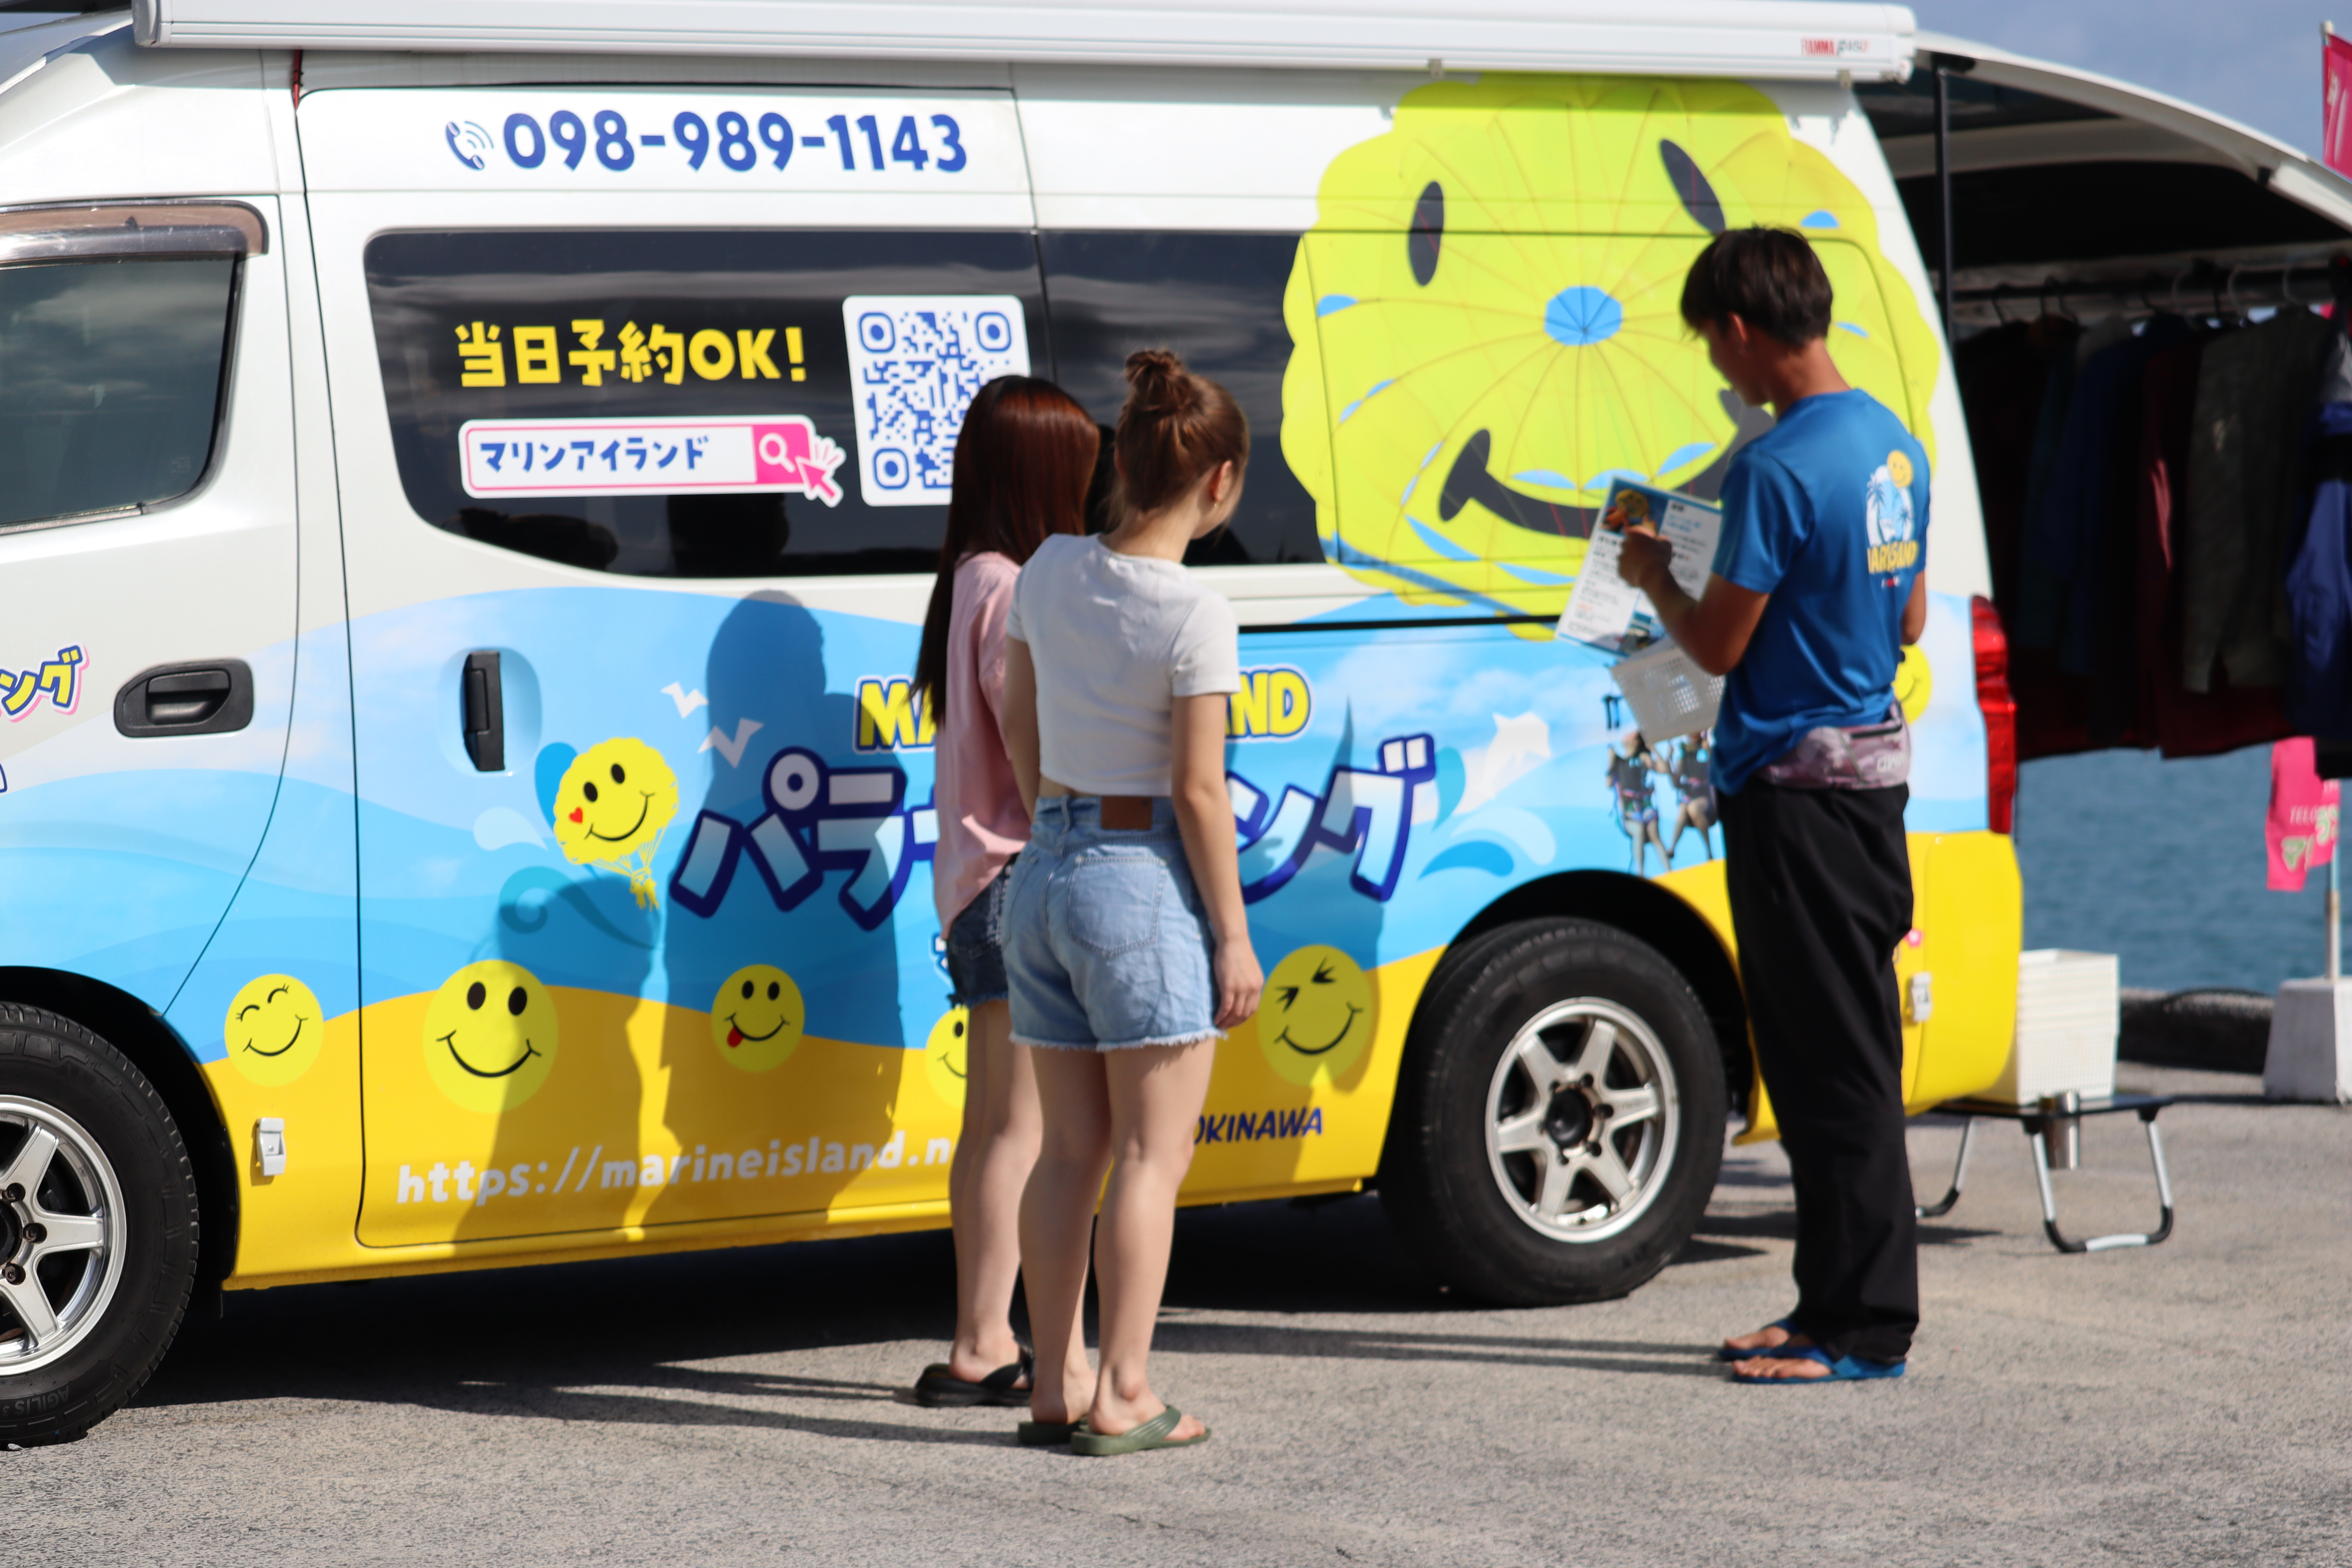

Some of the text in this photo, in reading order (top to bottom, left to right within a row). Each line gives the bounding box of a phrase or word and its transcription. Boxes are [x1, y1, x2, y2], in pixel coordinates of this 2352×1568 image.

[503, 109, 967, 172] 098-989-1143
[455, 319, 806, 387] 当日予約OK!
[479, 436, 709, 472] マリンアイランド
[396, 1129, 957, 1207] https://marineisland.n
[15, 1385, 69, 1416] AGILIS
